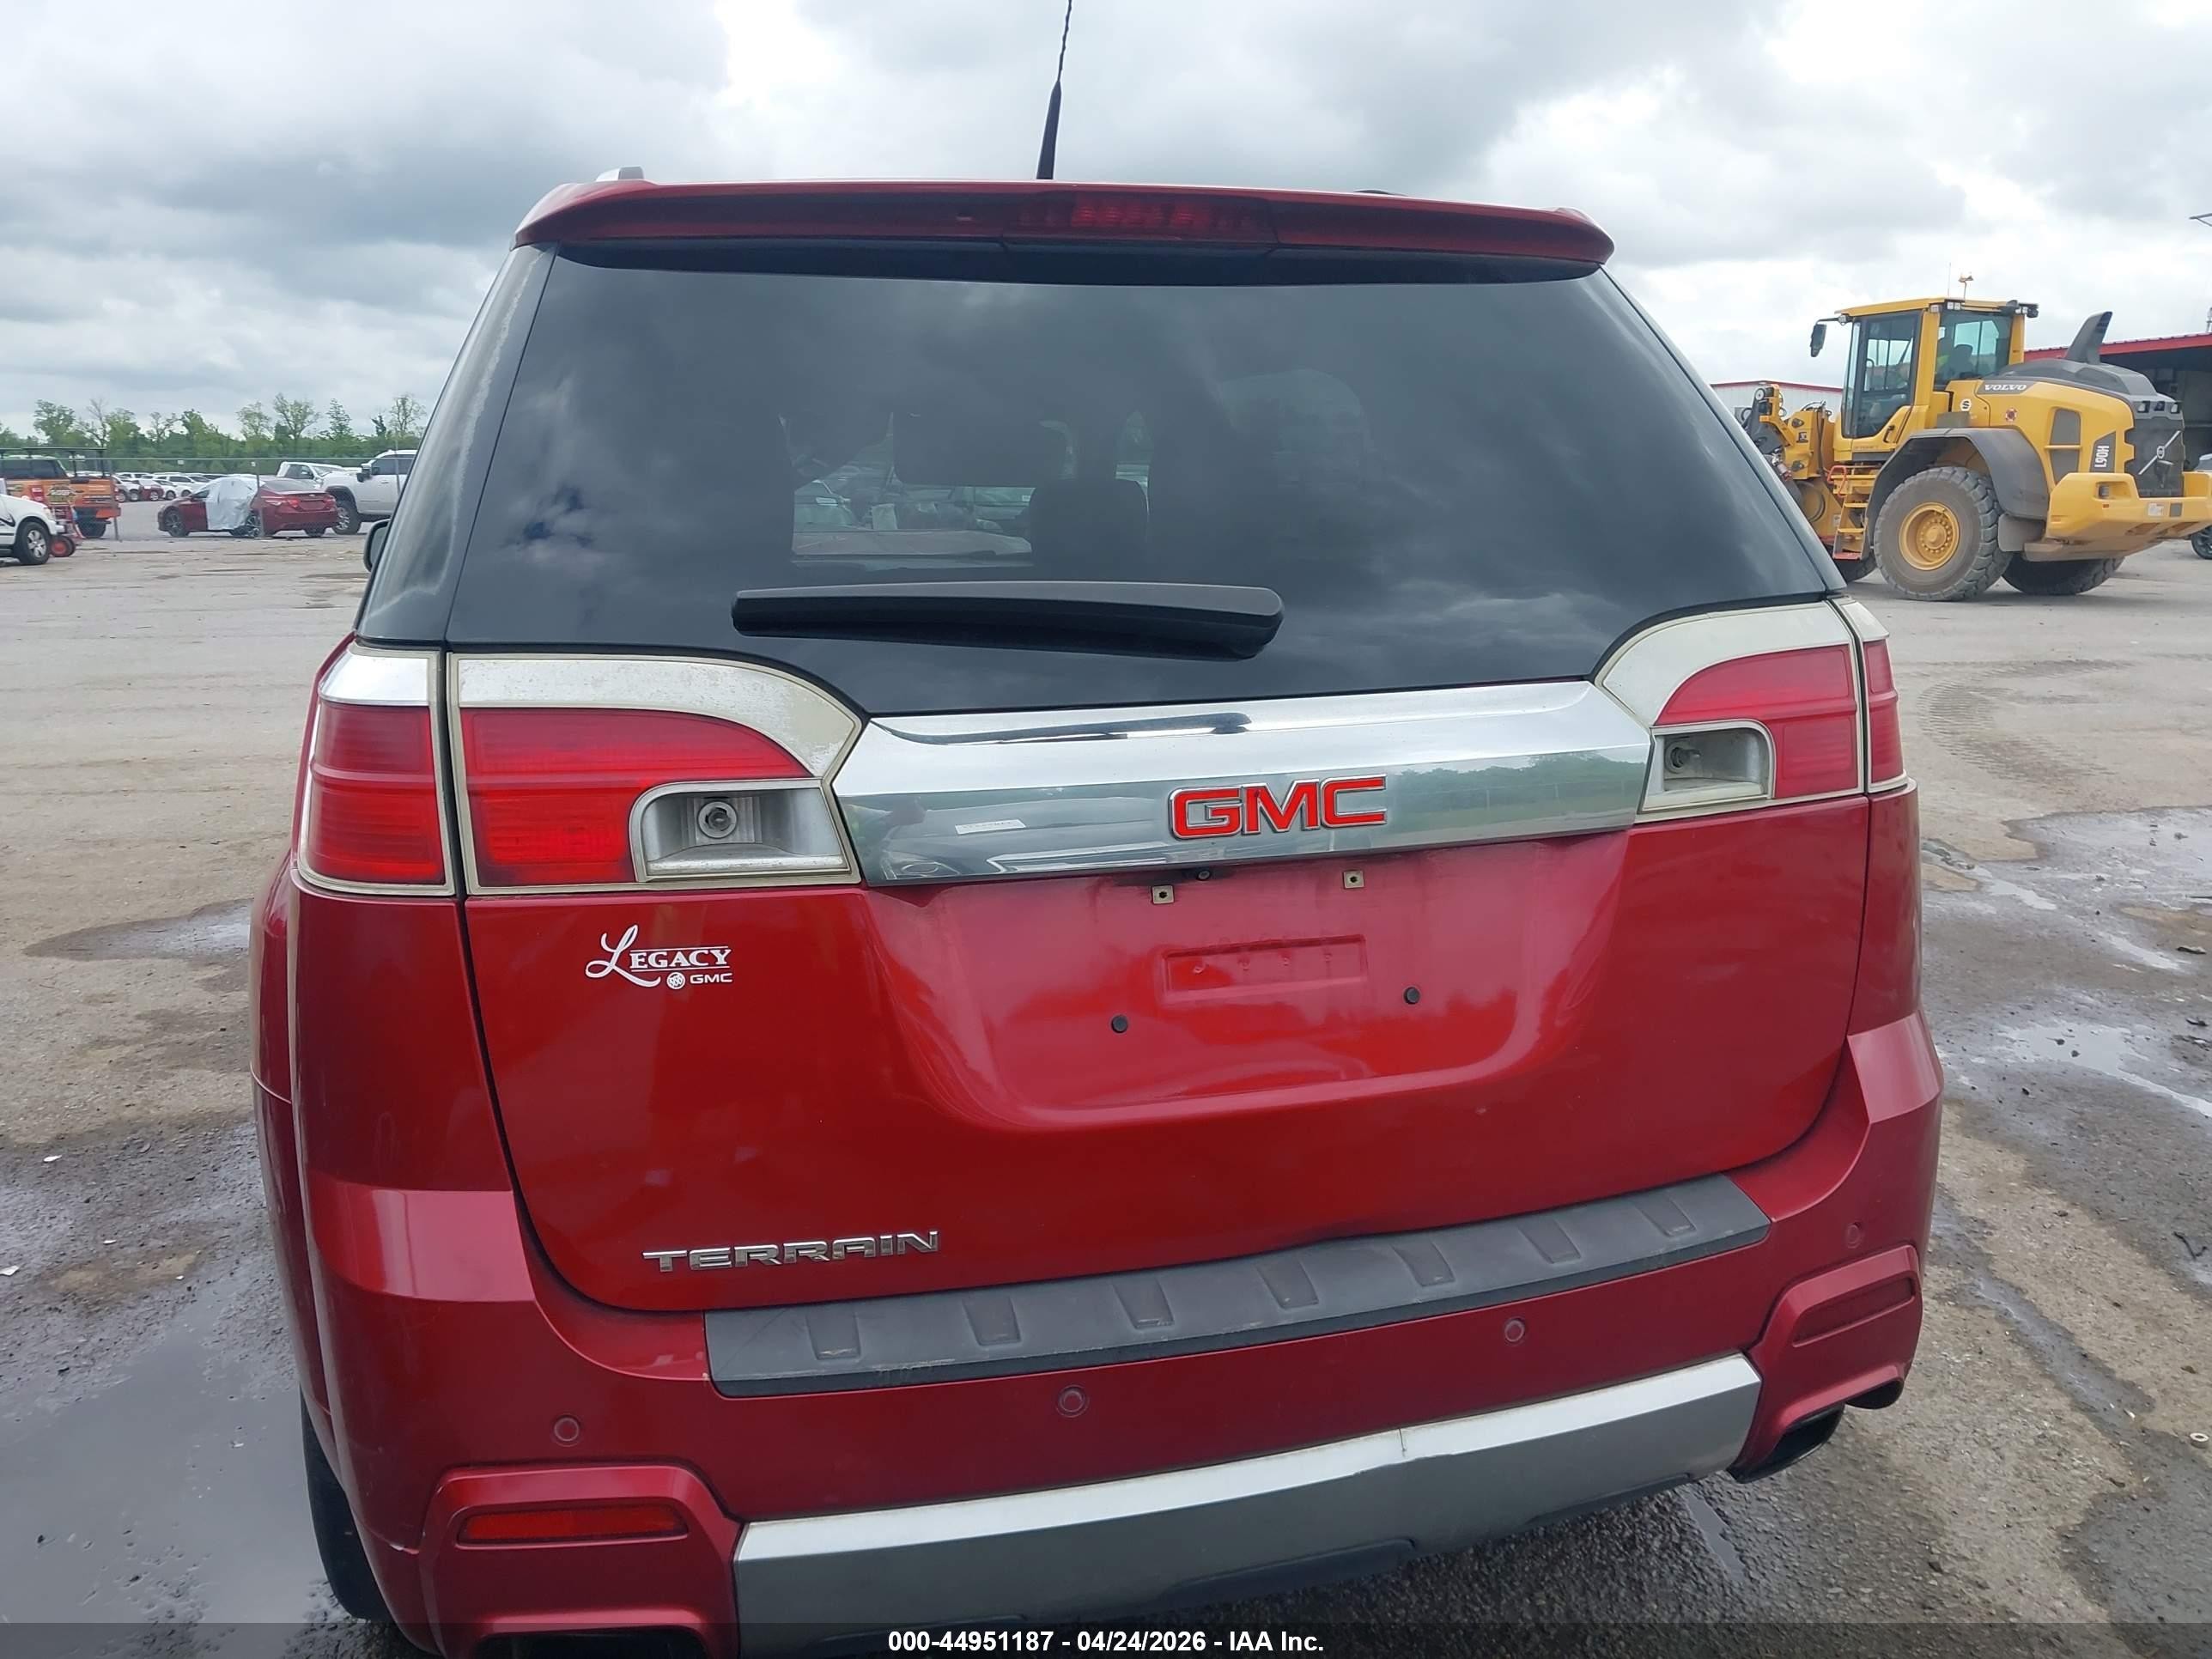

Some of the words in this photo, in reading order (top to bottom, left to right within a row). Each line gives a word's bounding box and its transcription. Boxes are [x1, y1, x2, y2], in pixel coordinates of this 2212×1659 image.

[2094, 445, 2110, 468] L90H
[1168, 774, 1387, 840] GMC
[690, 973, 732, 984] GMC
[642, 1231, 939, 1272] TERRAIN
